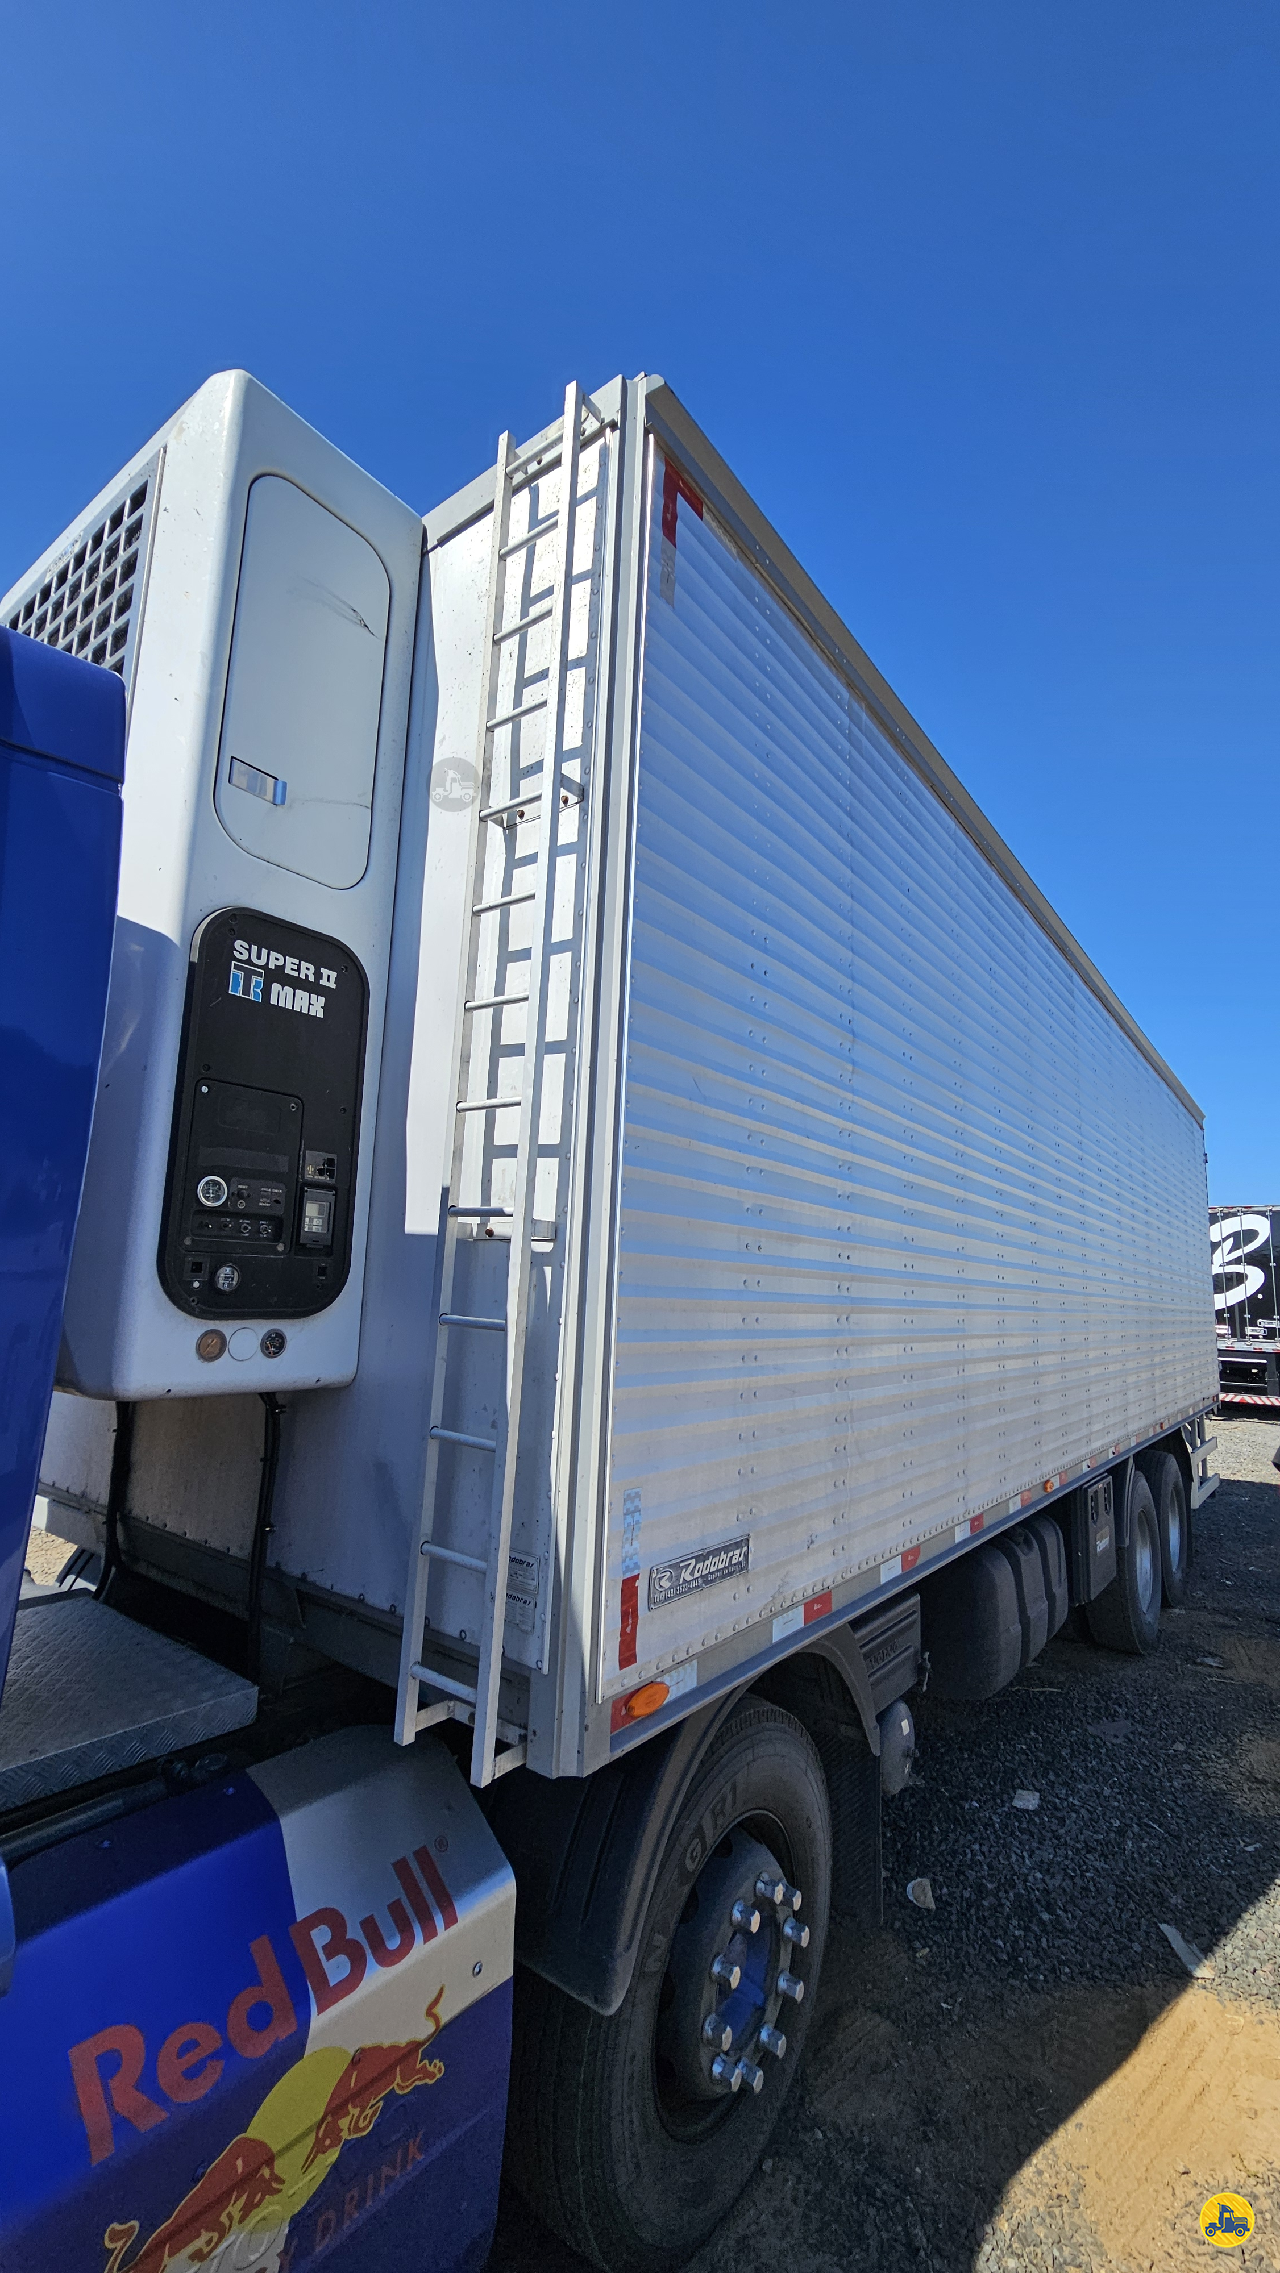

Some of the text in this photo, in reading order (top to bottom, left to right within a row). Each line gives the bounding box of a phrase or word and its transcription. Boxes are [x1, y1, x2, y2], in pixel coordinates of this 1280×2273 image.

[233, 939, 315, 982] SUPER
[270, 982, 326, 1019] MAX
[68, 1844, 459, 2166] Red Bull
[315, 2127, 424, 2253] DRINK
